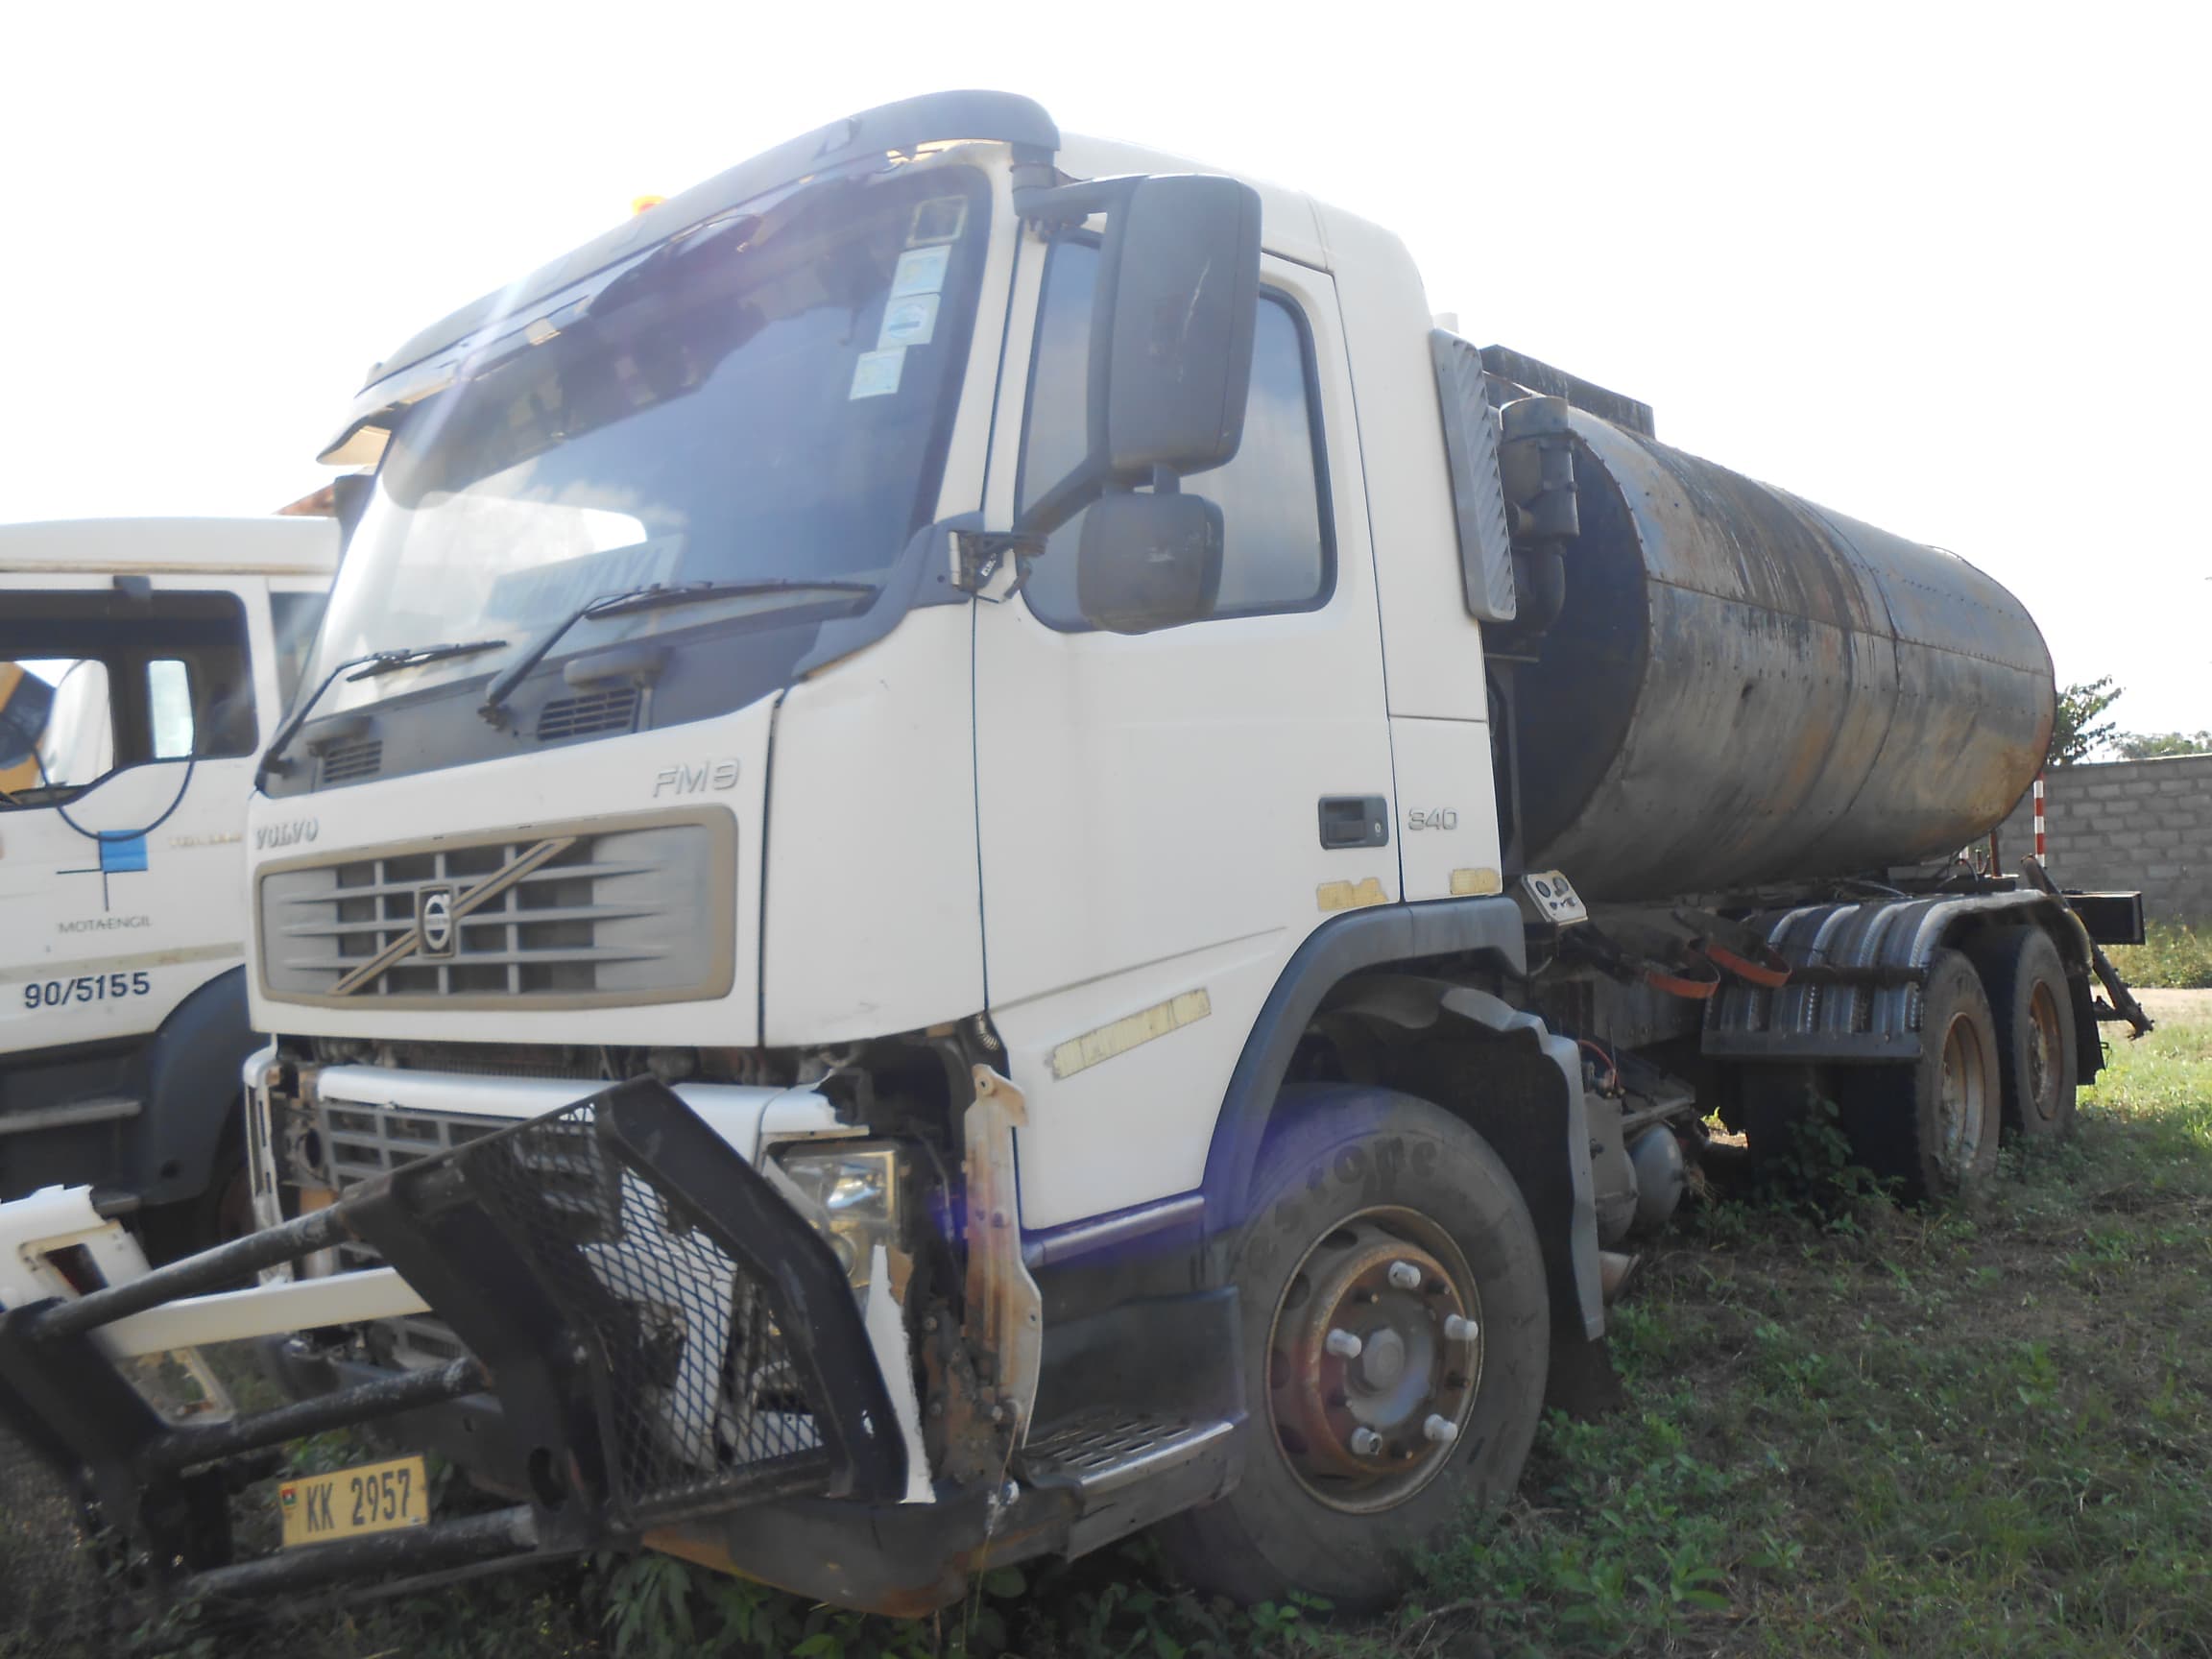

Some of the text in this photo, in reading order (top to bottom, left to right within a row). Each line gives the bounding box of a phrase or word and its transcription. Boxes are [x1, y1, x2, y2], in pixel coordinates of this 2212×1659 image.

[253, 816, 320, 851] VOLVO
[24, 972, 151, 1009] 90/5155
[306, 1467, 411, 1533] KK 2957
